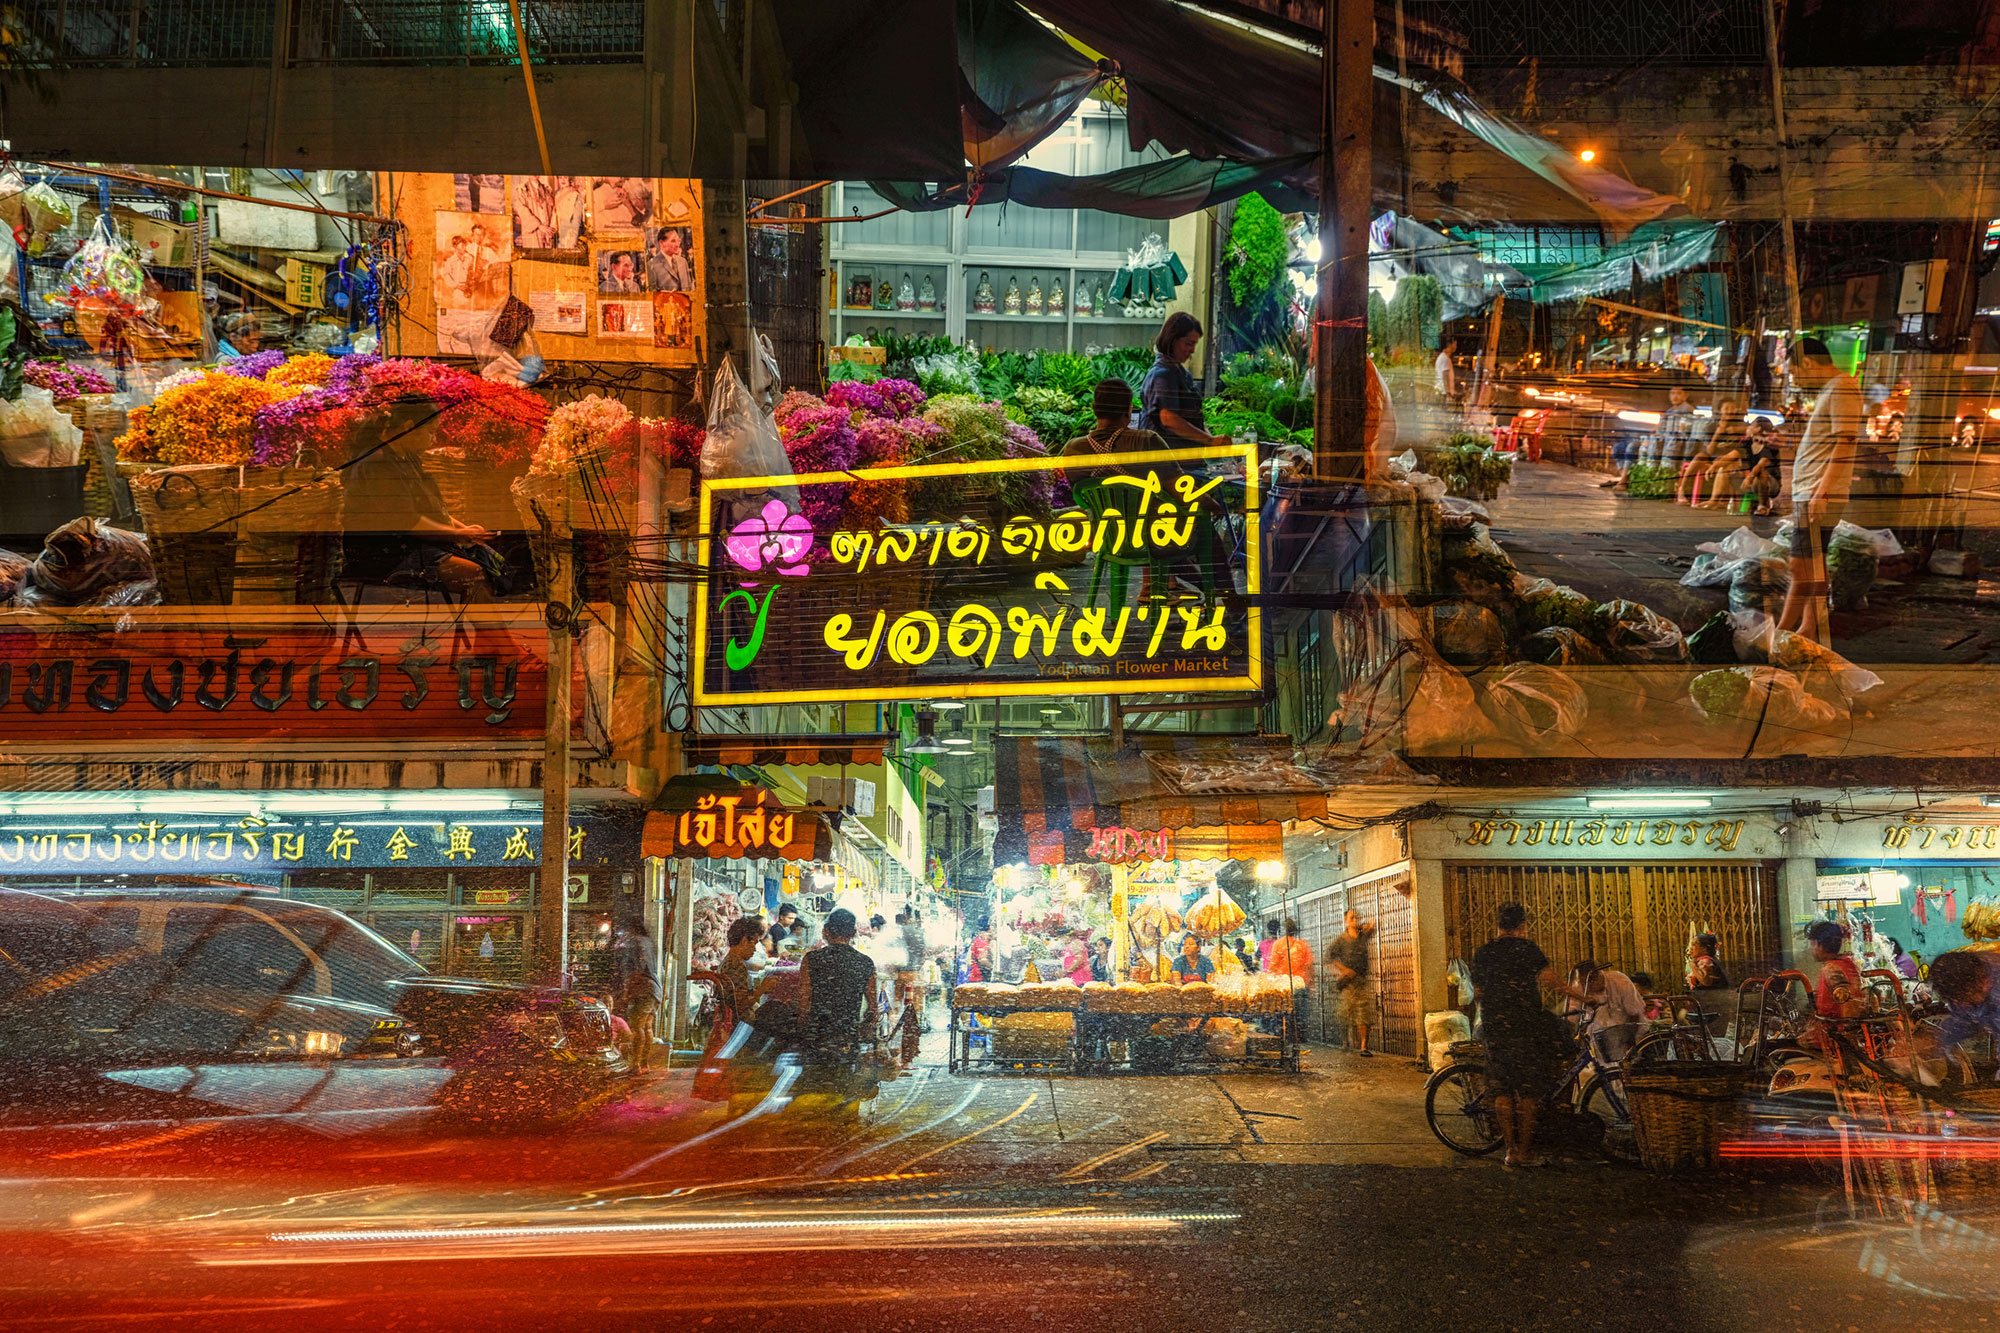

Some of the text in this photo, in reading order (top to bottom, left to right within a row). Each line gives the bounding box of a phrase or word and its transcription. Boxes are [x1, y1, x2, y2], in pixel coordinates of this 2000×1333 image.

[823, 572, 1227, 670] ยอดพิมาน
[0, 634, 518, 724] ทองชัยเจริญ
[1037, 655, 1229, 680] Yodpiman Flower Market
